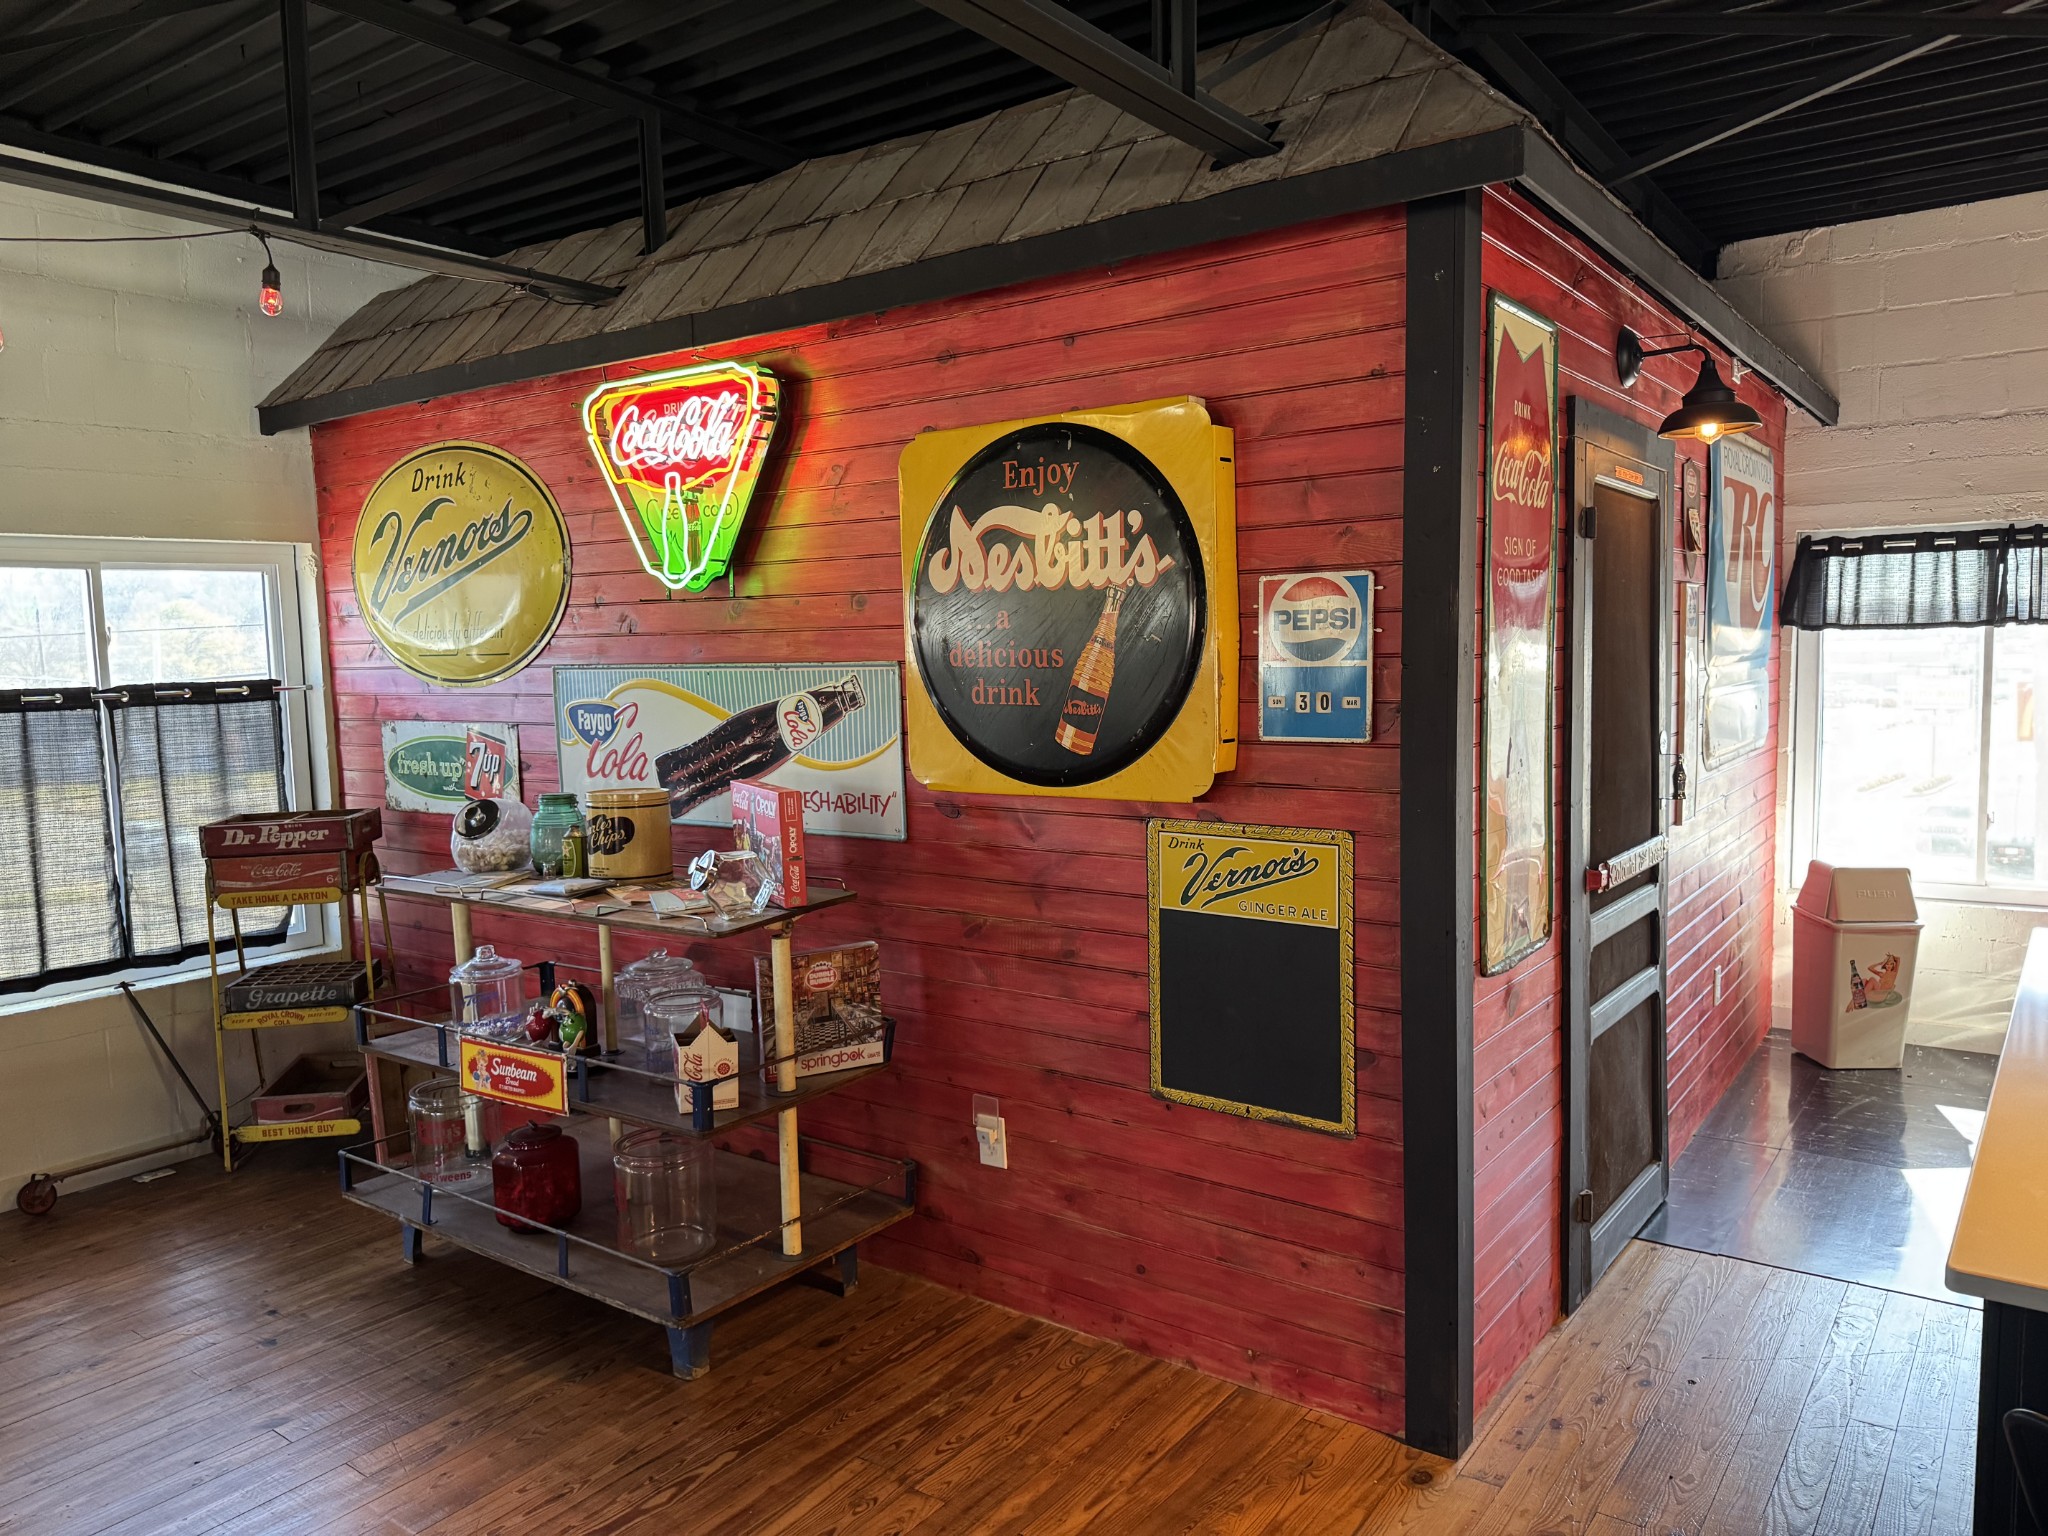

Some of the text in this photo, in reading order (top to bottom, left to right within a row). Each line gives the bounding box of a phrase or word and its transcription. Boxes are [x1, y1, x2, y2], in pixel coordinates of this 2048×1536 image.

[1514, 400, 1531, 420] DRINK
[611, 391, 738, 467] Coca-Cola
[1002, 457, 1080, 496] Enjoy
[1492, 441, 1549, 509] Coca-Cola
[1723, 446, 1742, 473] ROYAL
[1742, 454, 1760, 482] CROWN
[411, 462, 467, 492] Drink
[928, 502, 1176, 594] Nesbitt's
[1504, 536, 1537, 557] SIGN OF
[1497, 567, 1545, 588] GOOD TASTE
[413, 611, 461, 645] deliciously
[1273, 607, 1356, 632] PEPSI
[949, 642, 1064, 668] delicious
[971, 678, 1041, 707] drink
[1299, 694, 1308, 711] 3
[1321, 694, 1330, 711] 0
[1064, 698, 1103, 716] Nesbitt's
[577, 709, 612, 736] Faygo
[783, 710, 816, 747] Cola
[586, 702, 649, 781] Cola
[397, 750, 439, 776] fresh
[443, 783, 457, 791] with
[755, 794, 777, 819] OPOLY
[221, 829, 256, 846] Dr
[789, 826, 797, 854] OPOLY
[1168, 836, 1205, 852] Drink
[789, 865, 801, 893] Coca-Cola
[1180, 844, 1320, 909] Vernor's
[231, 890, 329, 906] TAKE HOME A CARTON
[1856, 889, 1896, 899] PUSH
[1238, 900, 1329, 921] GINGER ALE
[245, 985, 337, 1009] Grapette
[257, 1010, 306, 1025] ROYAL CROWN
[490, 1057, 537, 1082] Sunbeam
[801, 1048, 865, 1071] springbok
[505, 1076, 520, 1087] Bread
[262, 1124, 336, 1138] BEST HOME BUY
